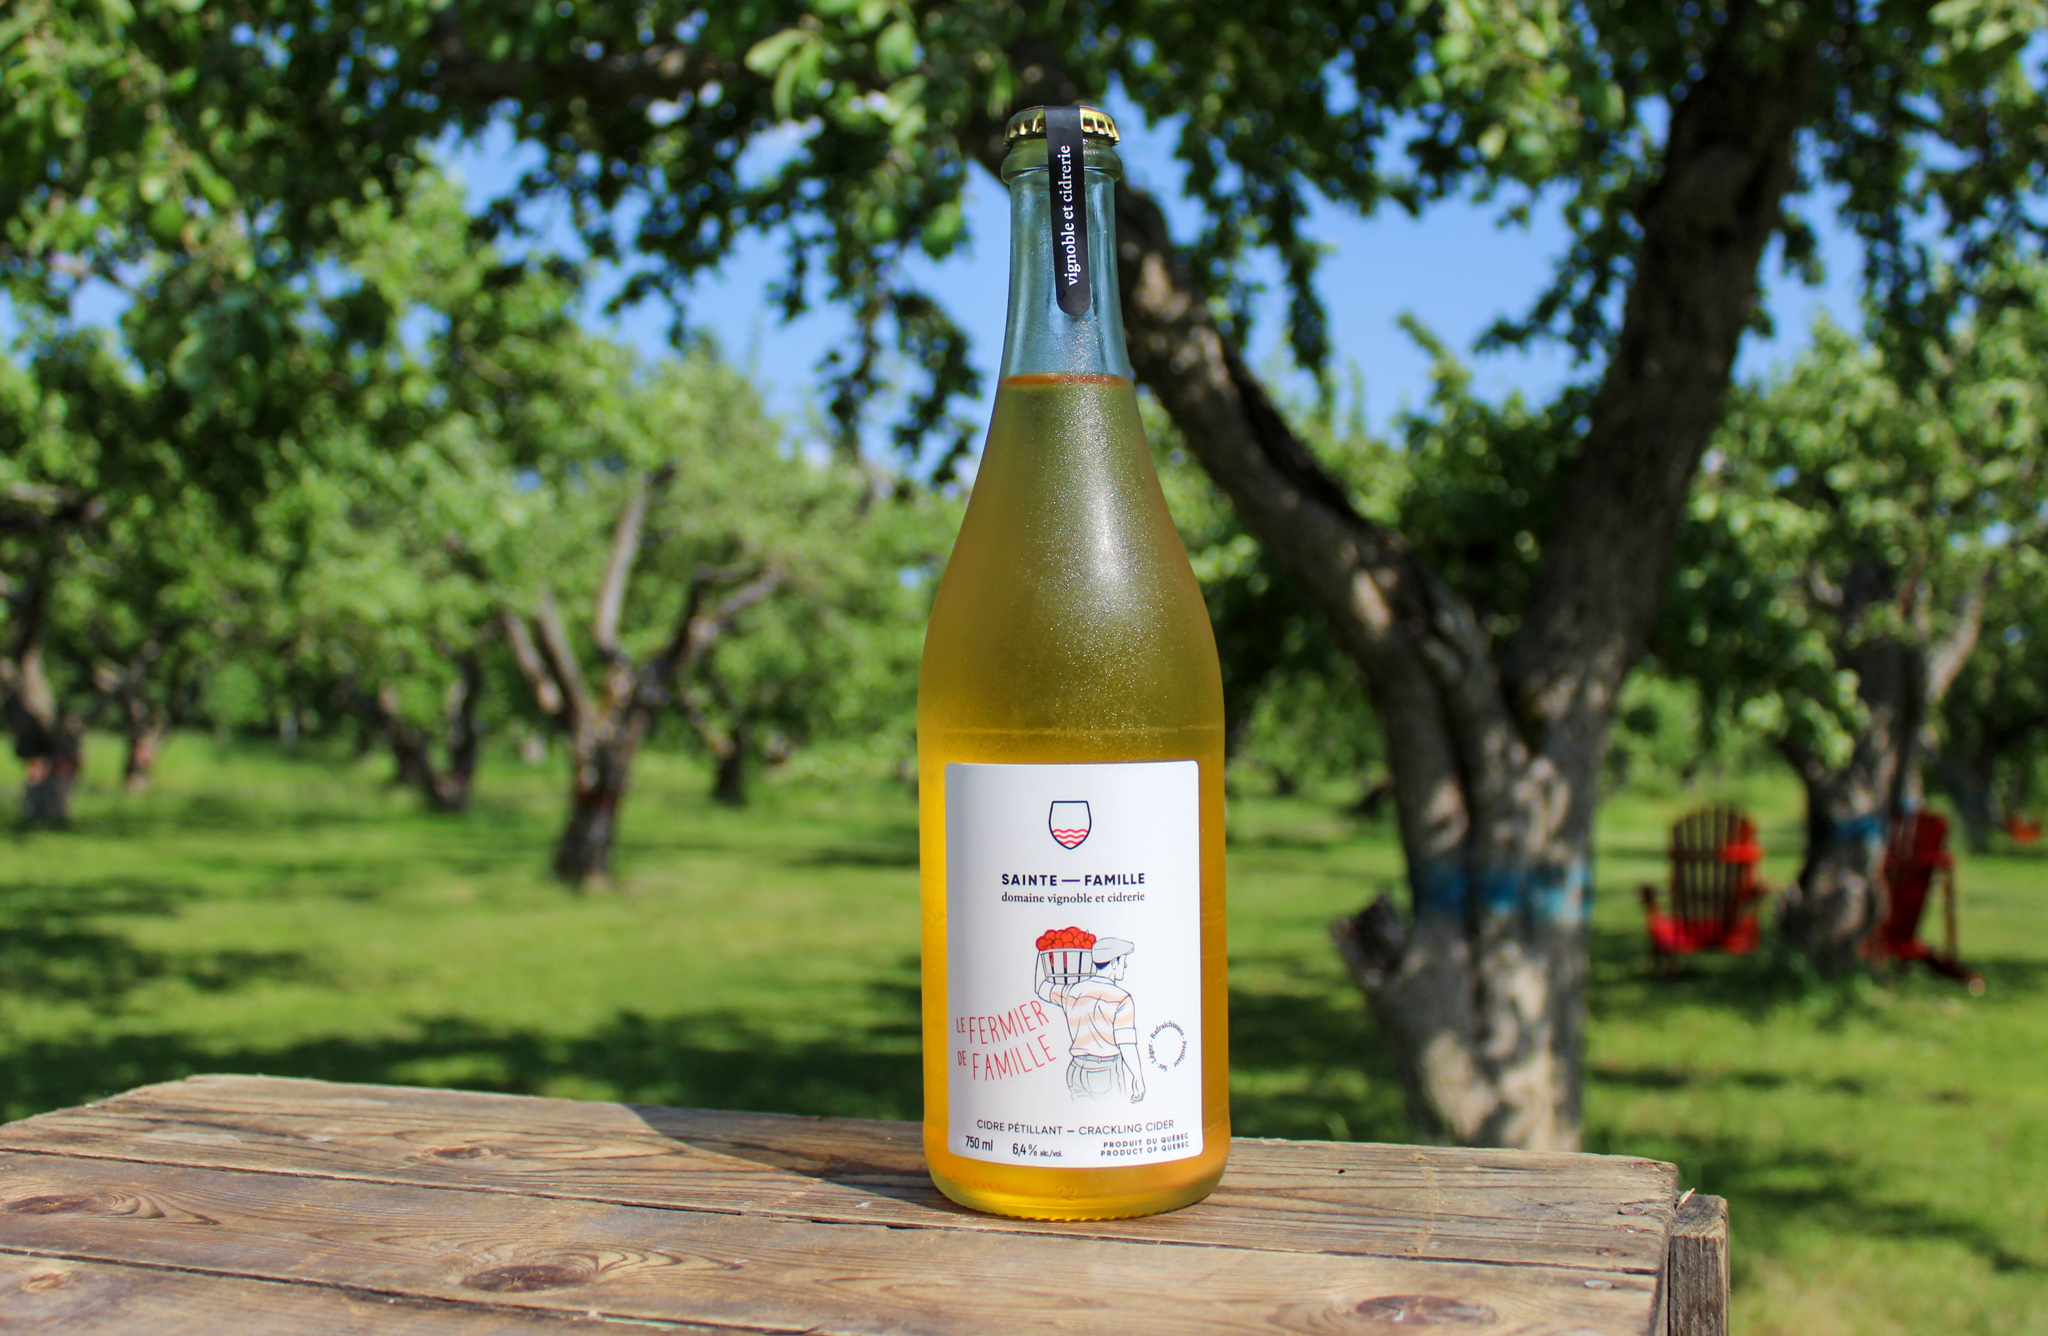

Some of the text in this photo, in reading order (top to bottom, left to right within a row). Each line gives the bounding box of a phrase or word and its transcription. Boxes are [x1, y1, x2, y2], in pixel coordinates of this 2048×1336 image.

[1057, 144, 1081, 286] vignoble et cidrerie
[1001, 873, 1058, 887] SAINTE
[1084, 872, 1146, 887] FAMILLE
[1001, 890, 1146, 906] domaine vignoble et cidrerie
[956, 1000, 1050, 1045] LE FERMIER
[957, 1034, 1057, 1081] DE FAMILLE
[976, 1119, 1005, 1132] CIDRE
[1008, 1122, 1063, 1135] PÉTILLANT
[1078, 1123, 1143, 1136] CRACKLING
[1145, 1119, 1174, 1132] CIDER
[965, 1135, 994, 1152] 750 ml
[1100, 1147, 1144, 1157] PRODUCT
[1146, 1146, 1158, 1154] OF
[1103, 1139, 1143, 1149] PRODUIT
[1146, 1138, 1158, 1146] DU
